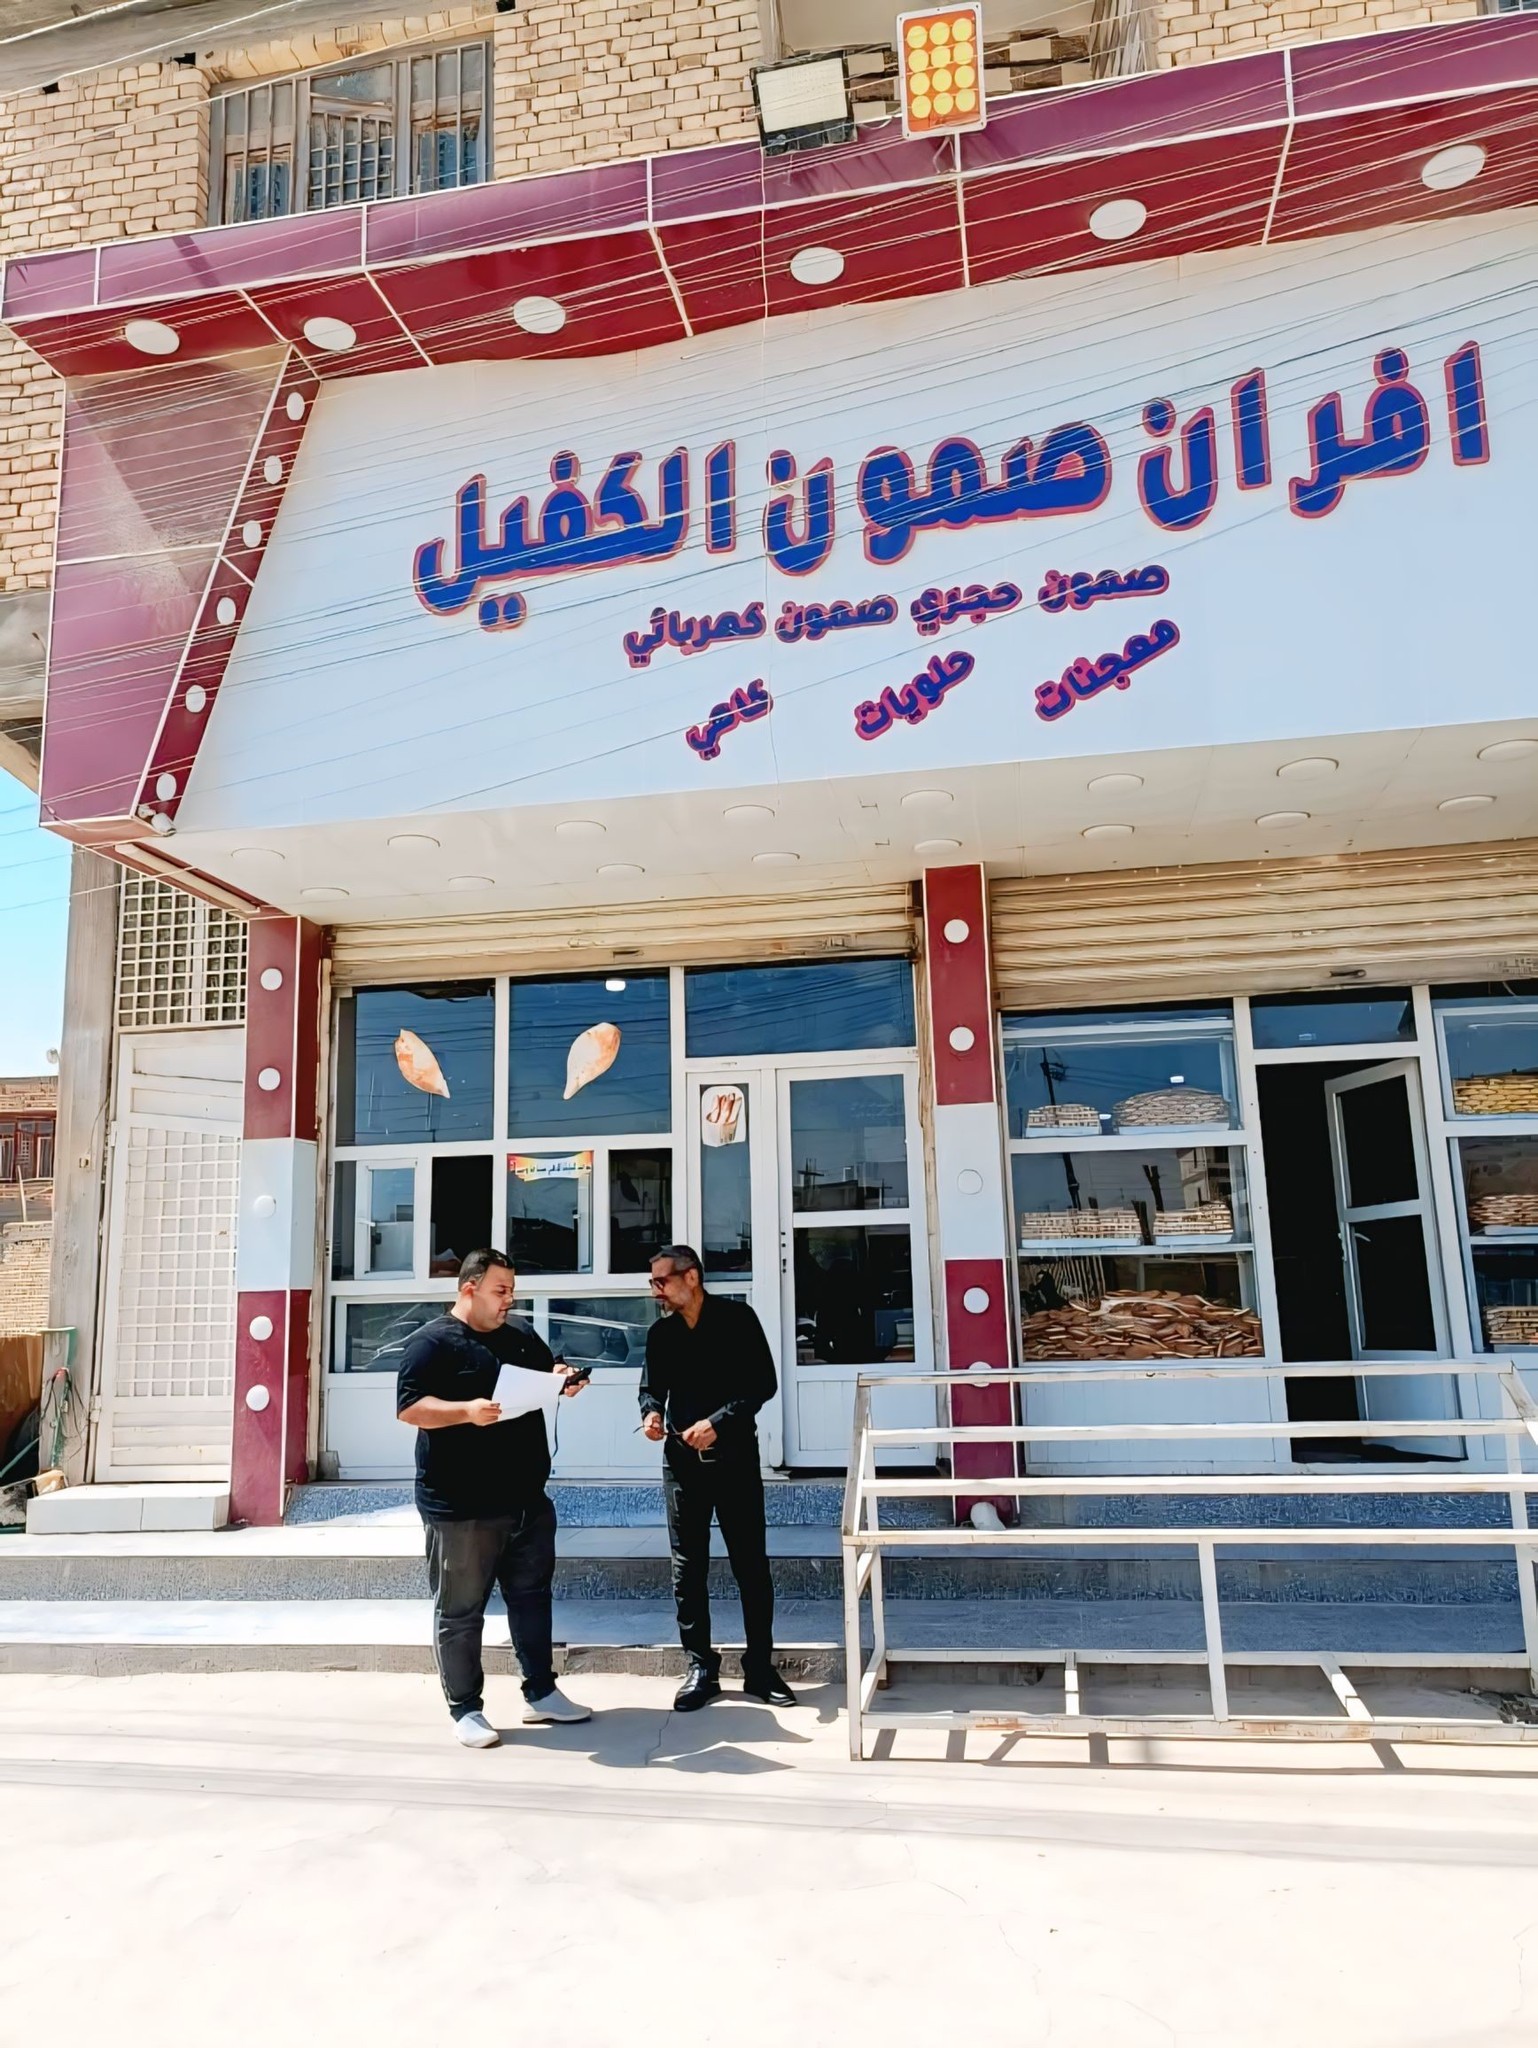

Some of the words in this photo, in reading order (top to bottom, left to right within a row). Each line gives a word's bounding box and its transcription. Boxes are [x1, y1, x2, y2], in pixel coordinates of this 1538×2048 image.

[1138, 341, 1489, 530] افران
[413, 439, 738, 632] الكفيل
[763, 421, 1112, 576] صمون
[775, 594, 898, 643] صمون
[910, 581, 1022, 636] حجري
[1038, 564, 1169, 613] صمون
[623, 601, 767, 668] كهربائي
[1035, 619, 1180, 721] معجنات
[686, 678, 774, 760] كاهي
[854, 650, 975, 740] حلويات
